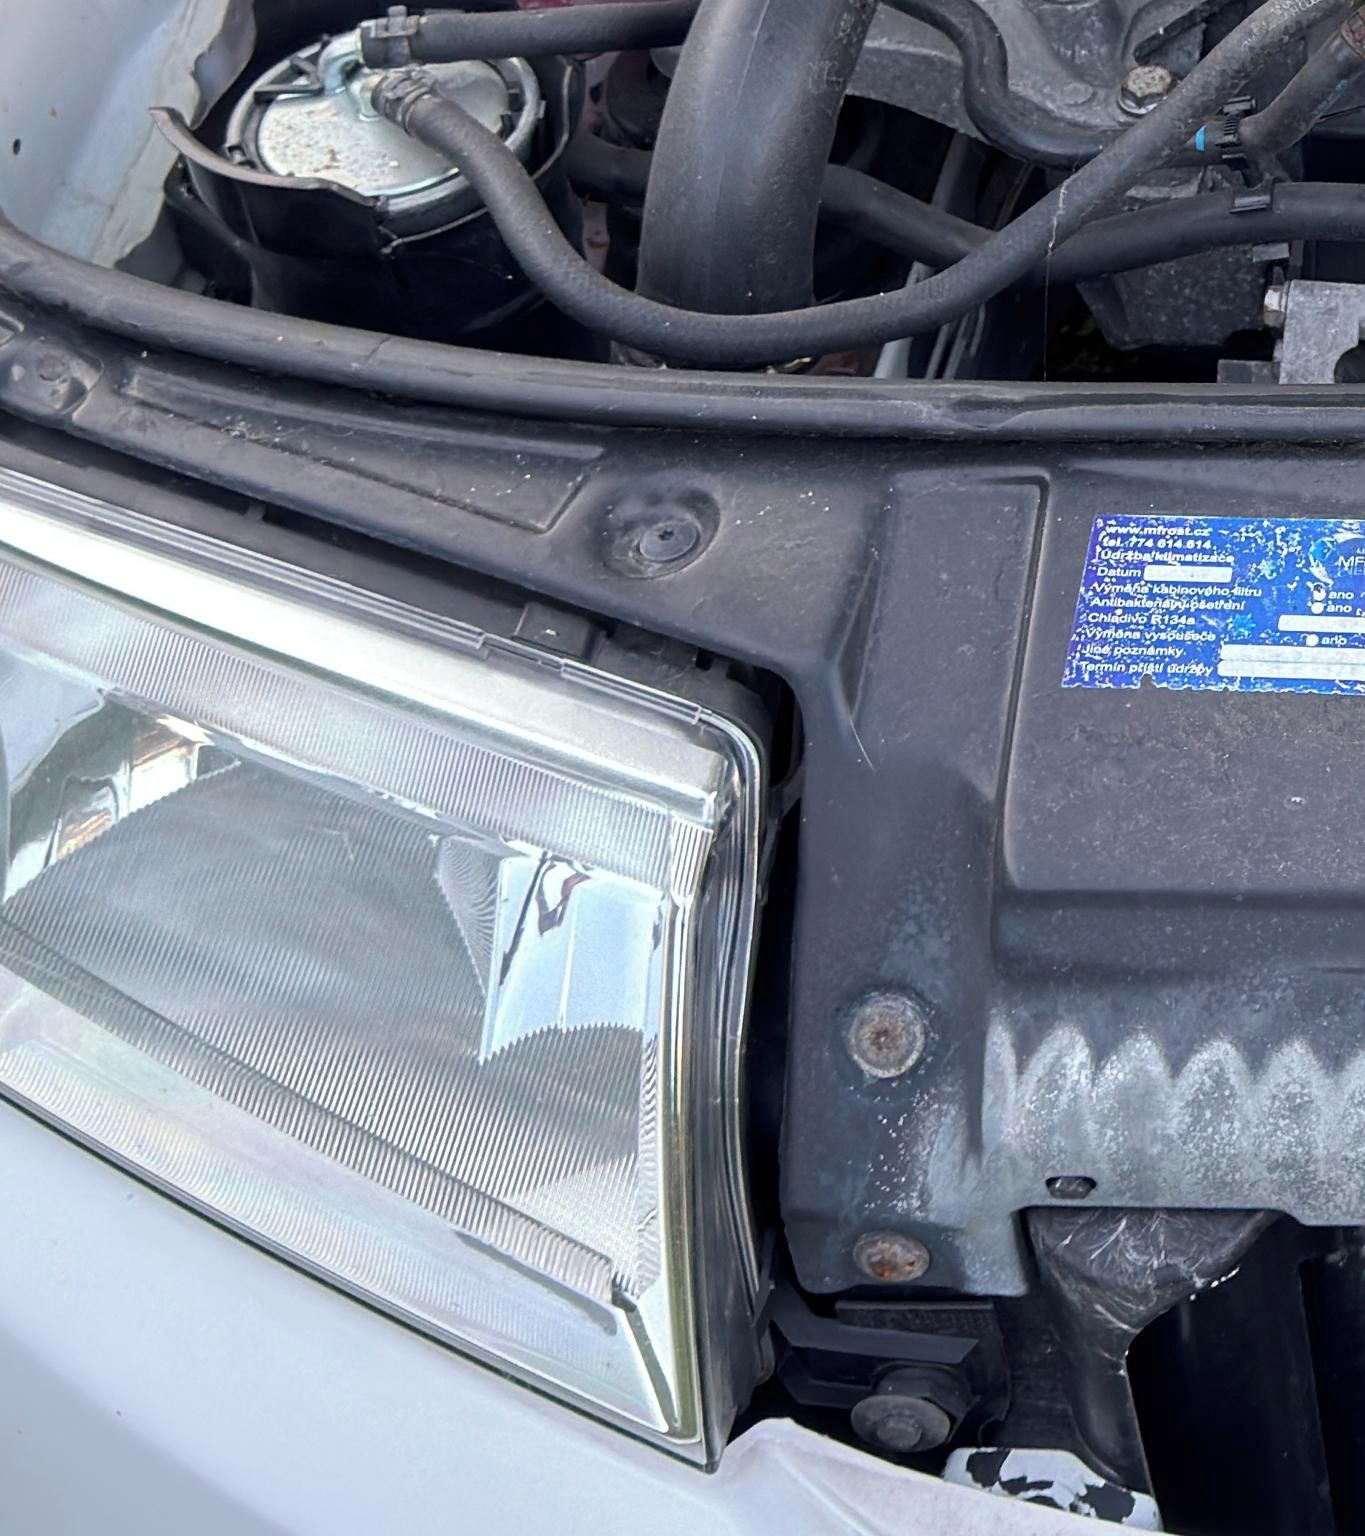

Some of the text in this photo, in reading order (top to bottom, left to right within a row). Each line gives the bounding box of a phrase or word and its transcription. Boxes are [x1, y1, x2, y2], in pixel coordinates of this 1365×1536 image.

[1106, 525, 1210, 536] www.mfrost.cz
[1103, 537, 1123, 547] tel.
[1157, 539, 1182, 549] 614
[1186, 540, 1211, 550] 614
[1097, 567, 1141, 577] Datum
[1329, 592, 1354, 600] ano
[1327, 605, 1352, 613] ano
[1088, 612, 1195, 625] Chladivo R134a
[1321, 637, 1347, 645] ano
